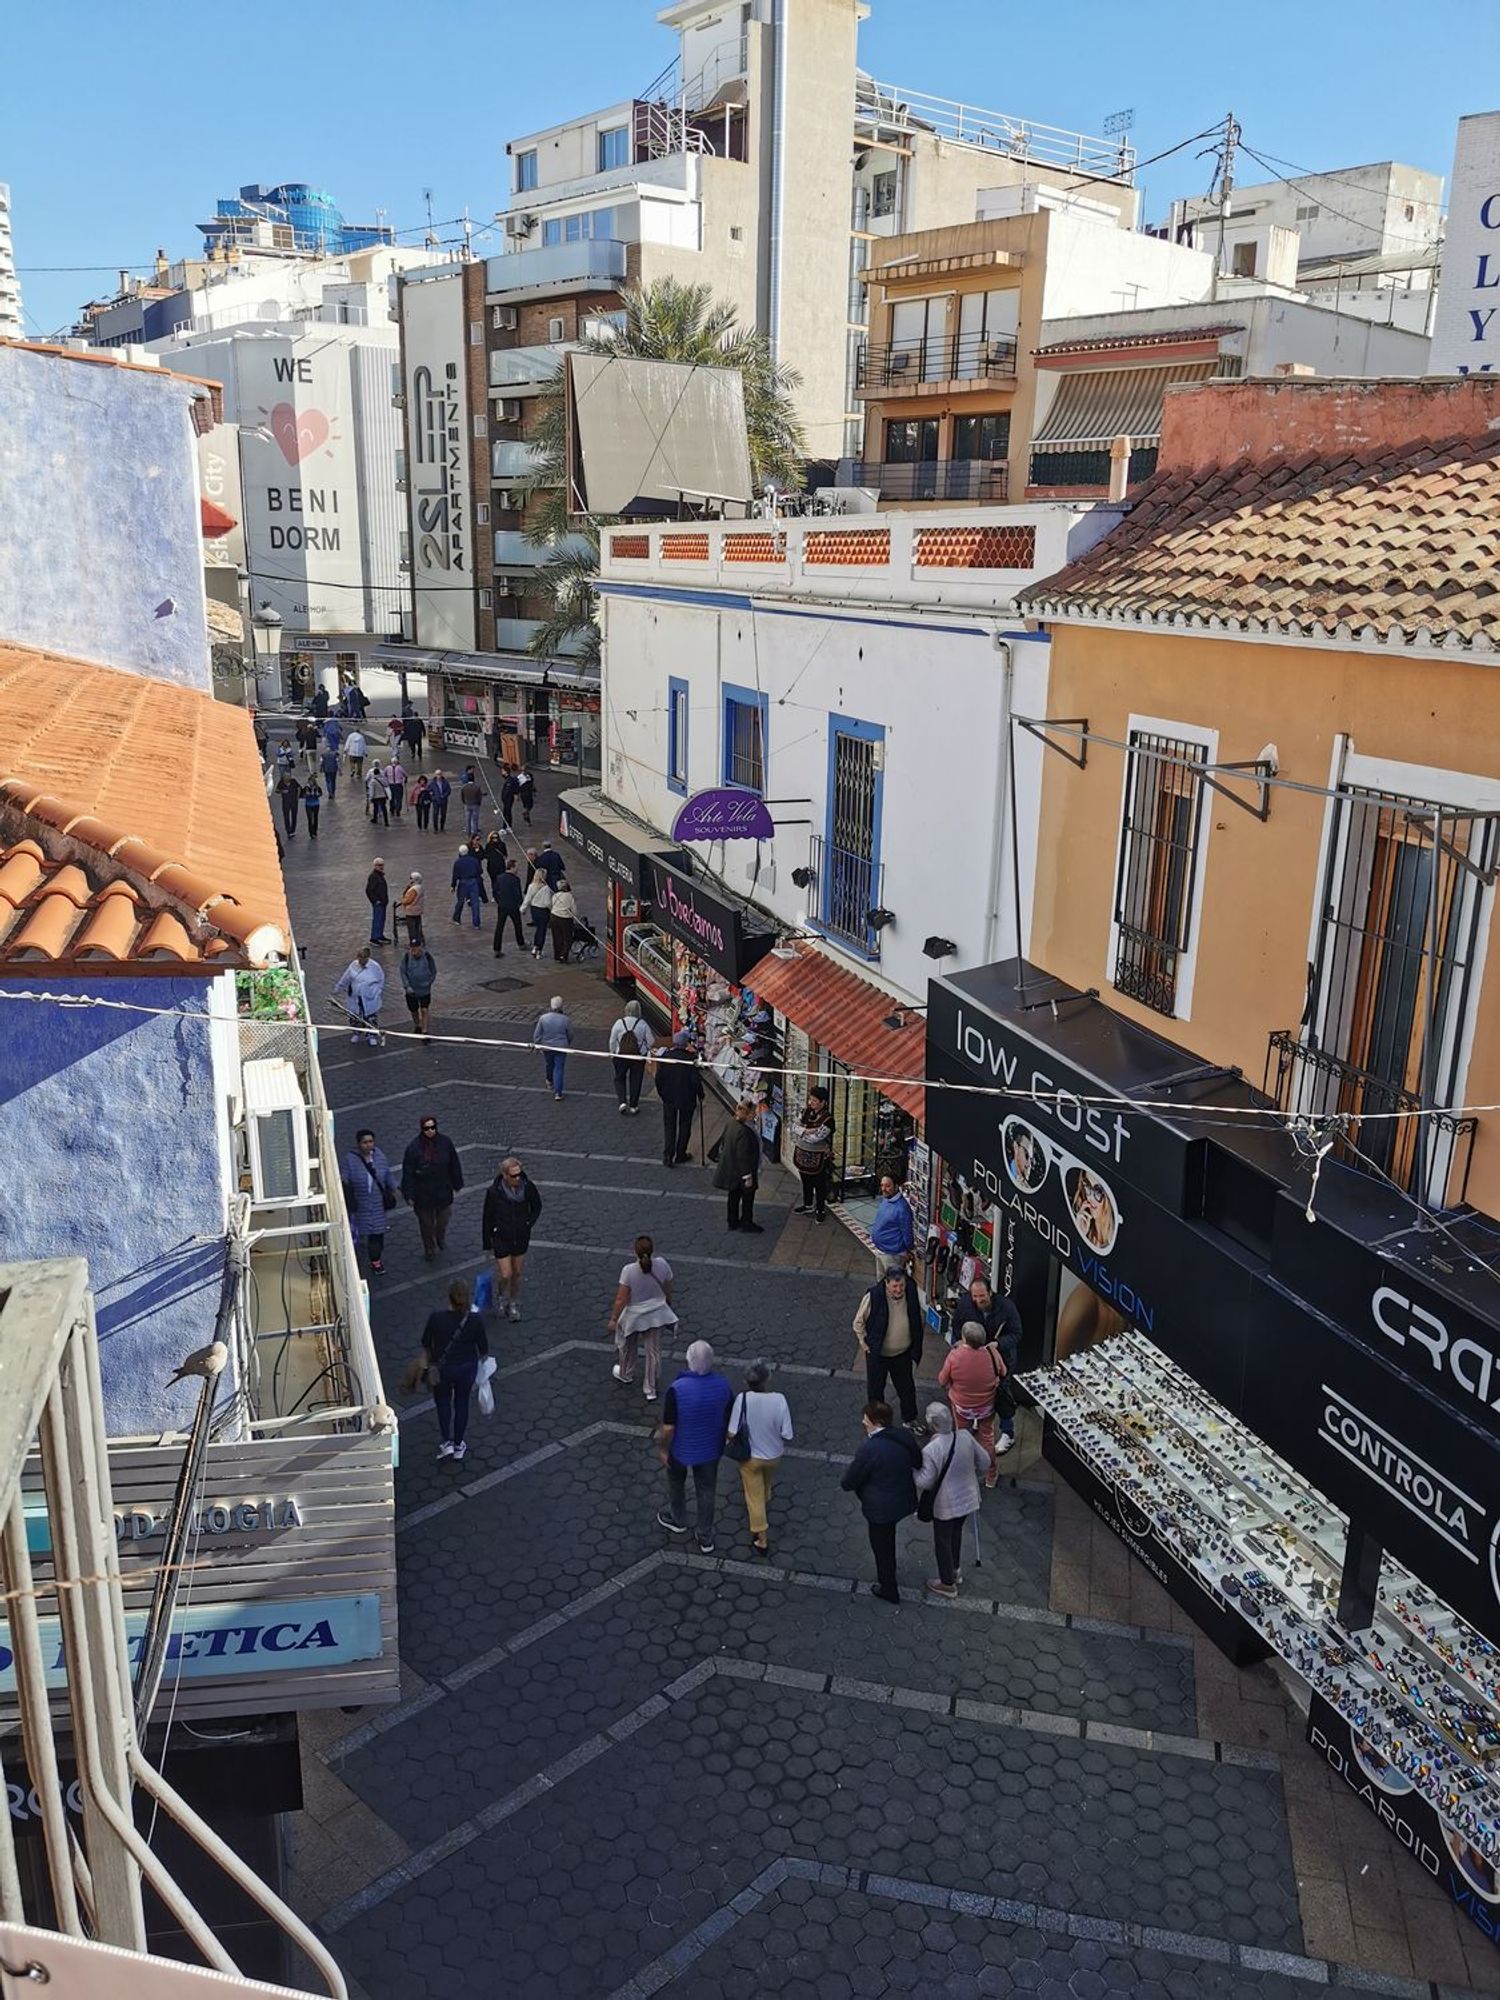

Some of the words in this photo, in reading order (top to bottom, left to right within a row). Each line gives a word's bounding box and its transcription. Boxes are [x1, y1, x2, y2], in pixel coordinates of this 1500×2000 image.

[273, 357, 313, 384] WE
[205, 452, 226, 496] City
[267, 487, 338, 514] BENI
[413, 365, 451, 571] 2SLEEP
[446, 362, 465, 572] APARTMENTS
[269, 525, 341, 551] DORM
[684, 801, 723, 824] Arte
[727, 799, 759, 823] Vela
[694, 825, 748, 834] SOUVENIRS
[973, 1158, 1071, 1258] POLAROID
[1077, 1246, 1154, 1331] VISION
[1371, 1286, 1500, 1414] CRA
[1324, 1404, 1470, 1541] CONTROLA
[1310, 1726, 1441, 1876] POLAROID
